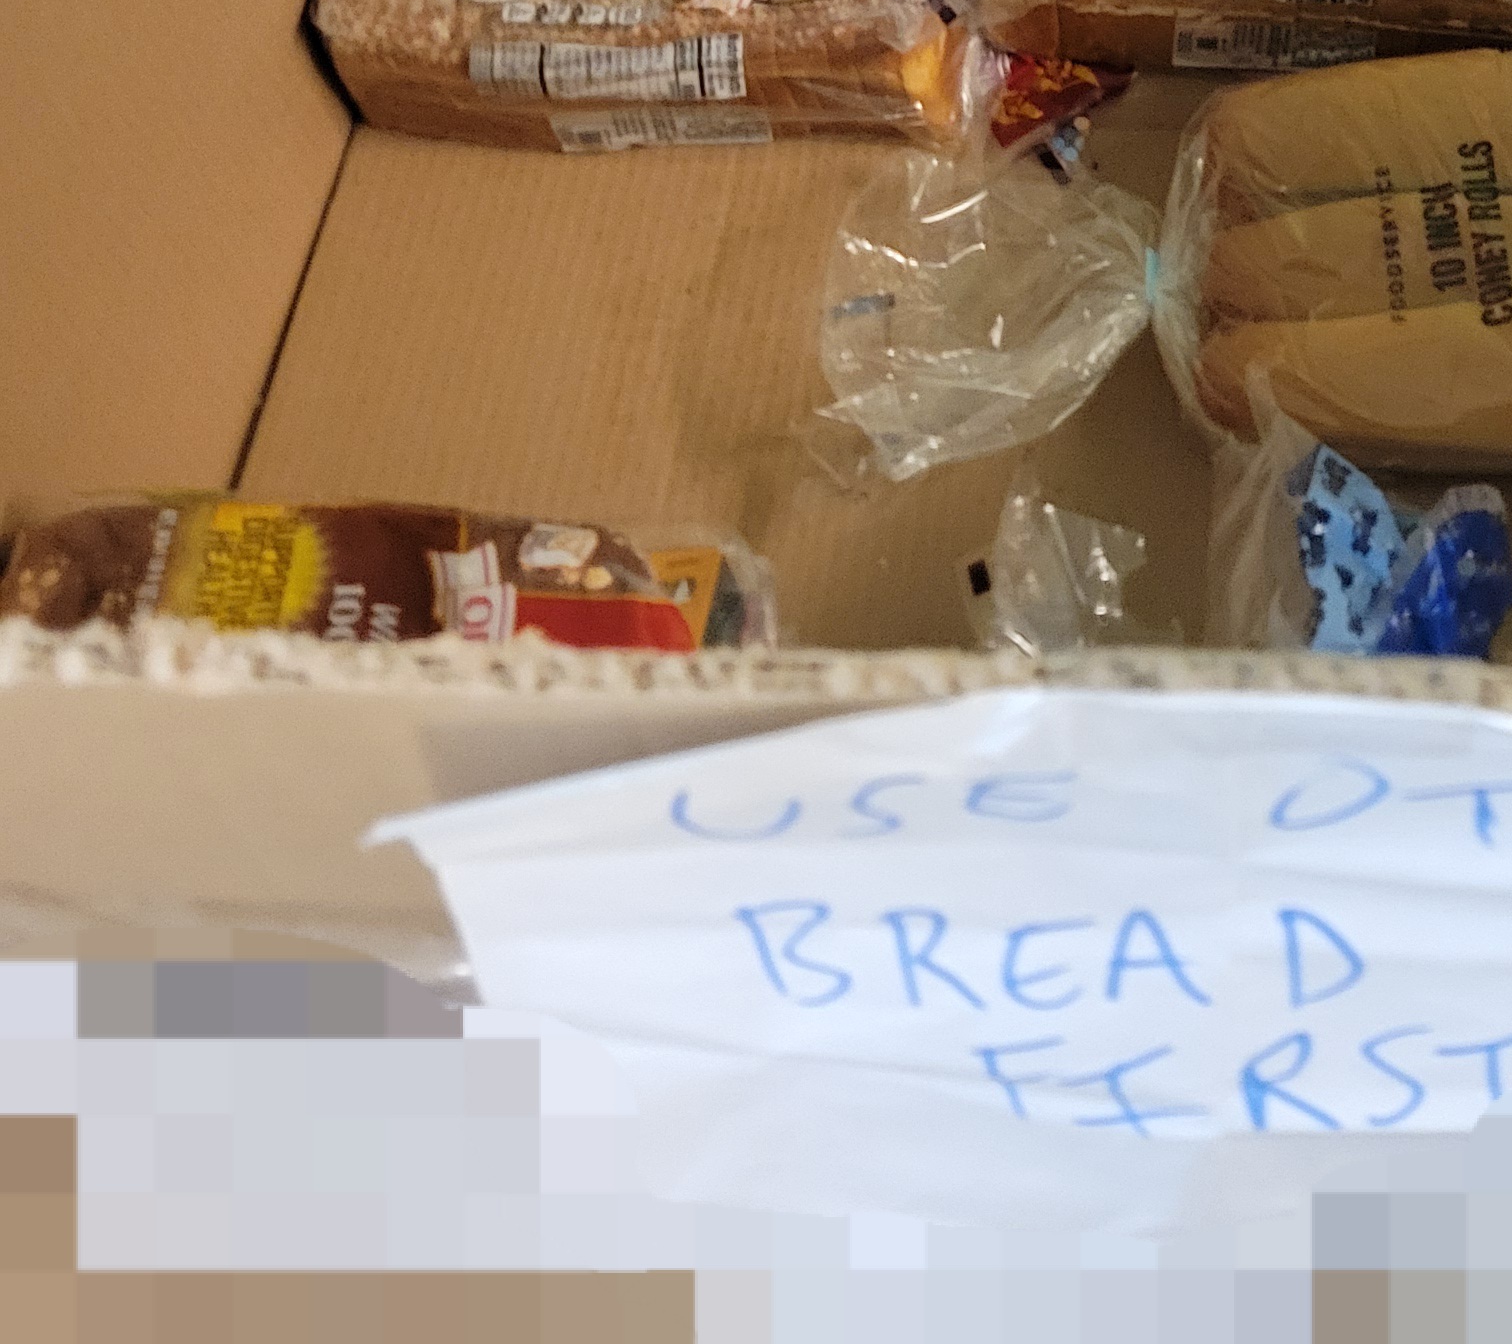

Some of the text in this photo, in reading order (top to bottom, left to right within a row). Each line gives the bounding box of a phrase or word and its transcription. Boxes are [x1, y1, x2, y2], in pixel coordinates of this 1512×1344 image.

[1458, 139, 1502, 220] ROLLS
[1420, 181, 1467, 292] 10 INCH
[670, 768, 1079, 845] USE
[736, 899, 1368, 1012] BREAD
